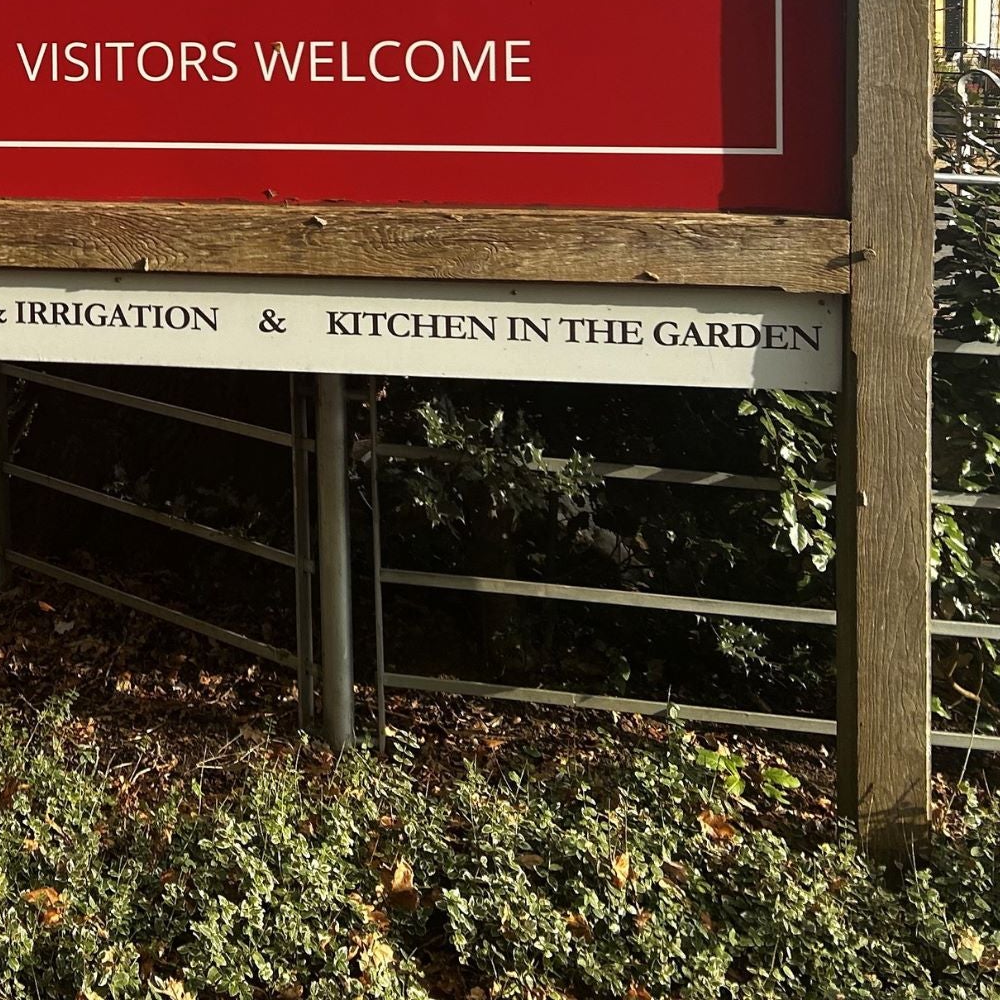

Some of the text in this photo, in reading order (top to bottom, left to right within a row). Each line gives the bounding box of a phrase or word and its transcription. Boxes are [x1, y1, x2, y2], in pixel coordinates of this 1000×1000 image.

[16, 40, 532, 83] VISITORS WELCOME
[15, 301, 219, 331] IRRIGATION
[258, 309, 287, 334] &
[326, 311, 497, 341] KITCHEN
[507, 316, 551, 343] IN
[558, 317, 644, 345] THE
[653, 320, 823, 352] GARDEN
